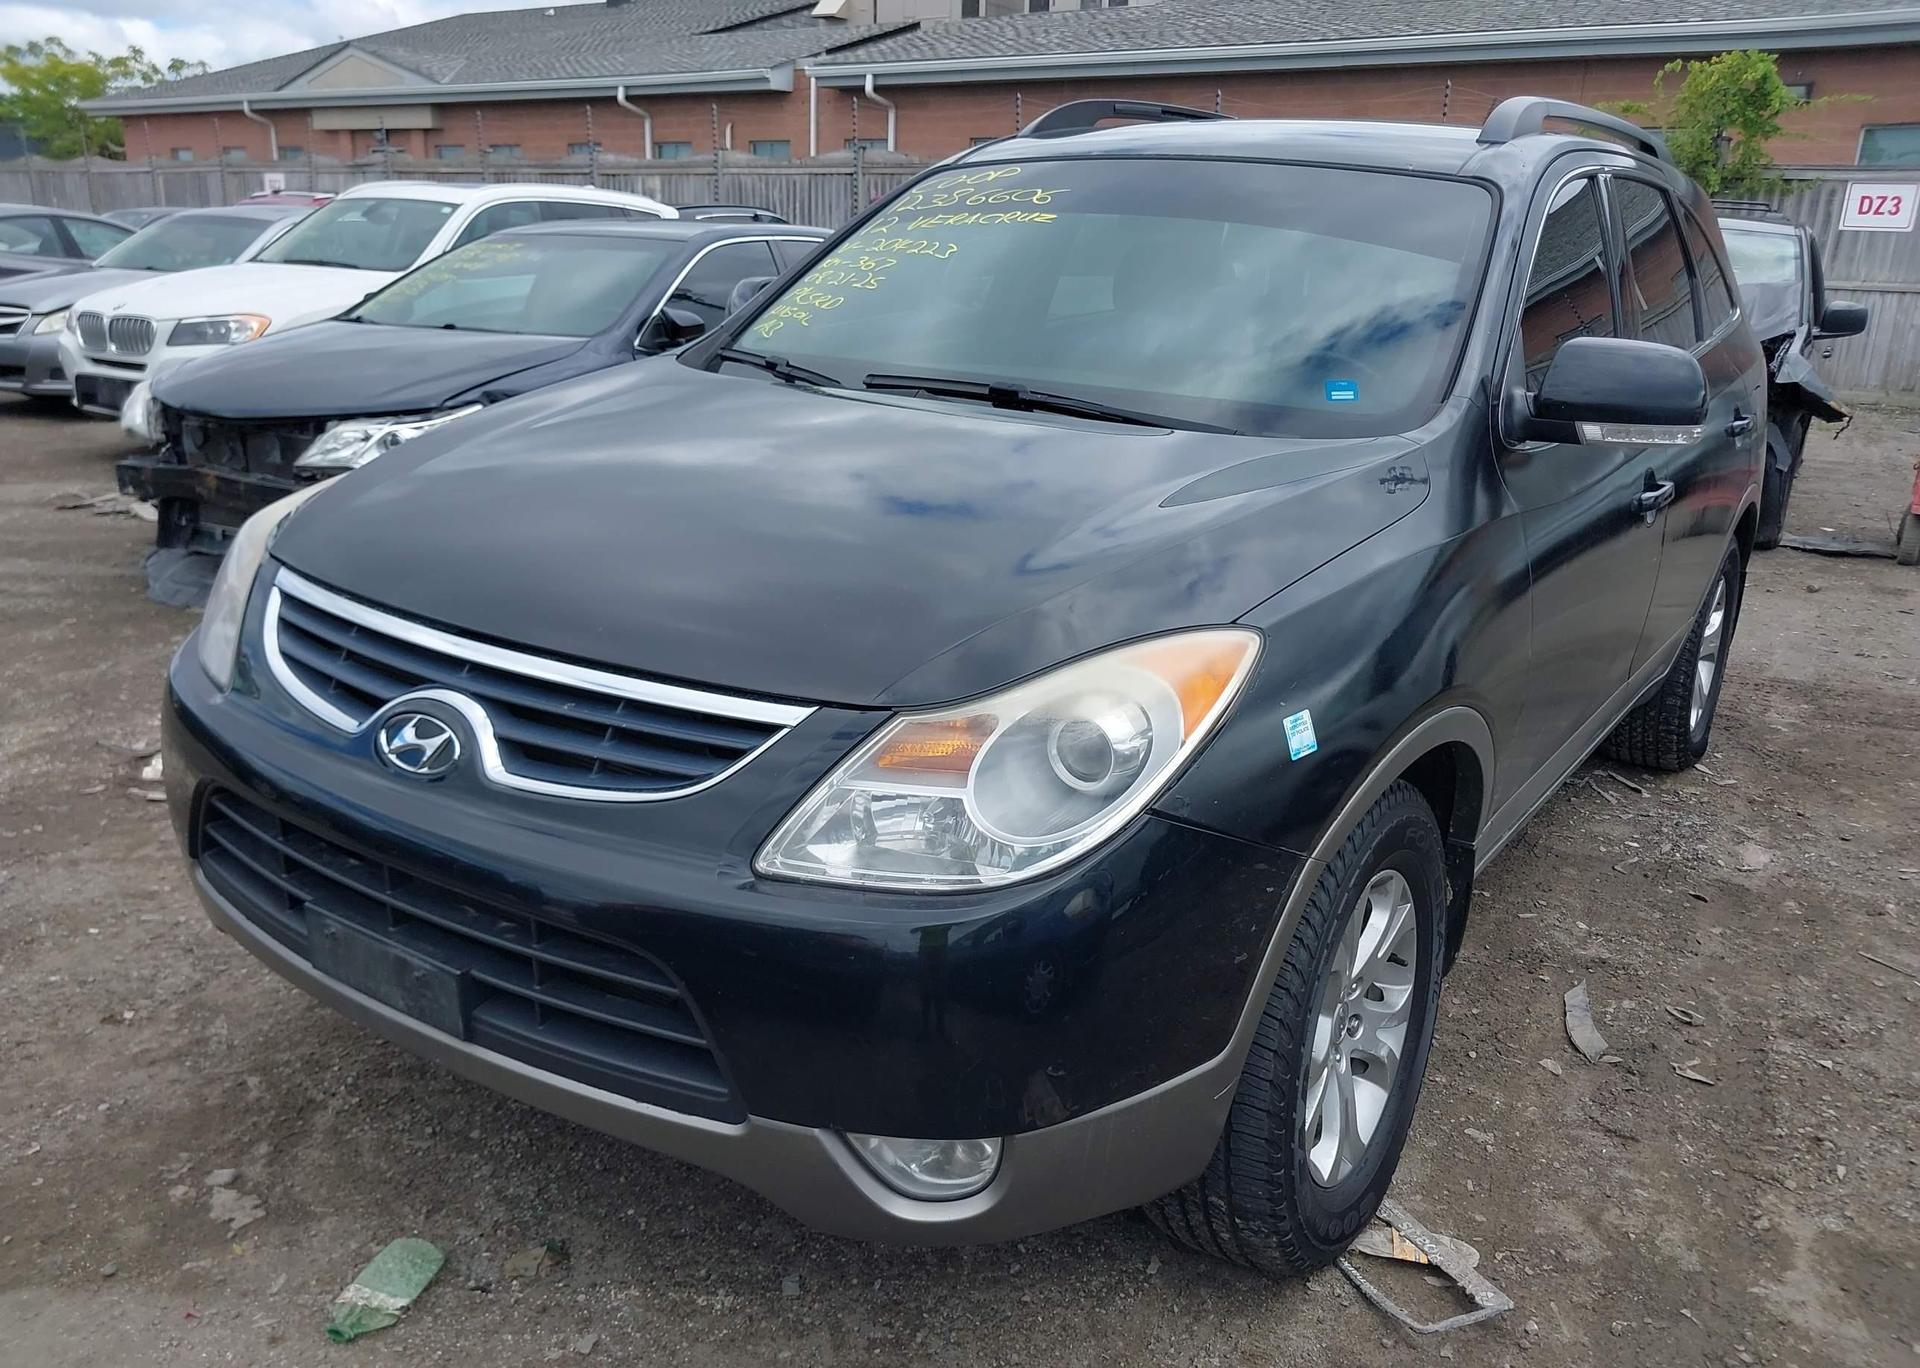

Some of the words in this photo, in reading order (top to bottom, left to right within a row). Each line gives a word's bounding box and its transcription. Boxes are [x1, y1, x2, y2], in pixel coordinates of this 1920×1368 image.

[1857, 195, 1902, 216] DZ3
[860, 216, 899, 236] 12
[907, 211, 1057, 231] VERACRUZ
